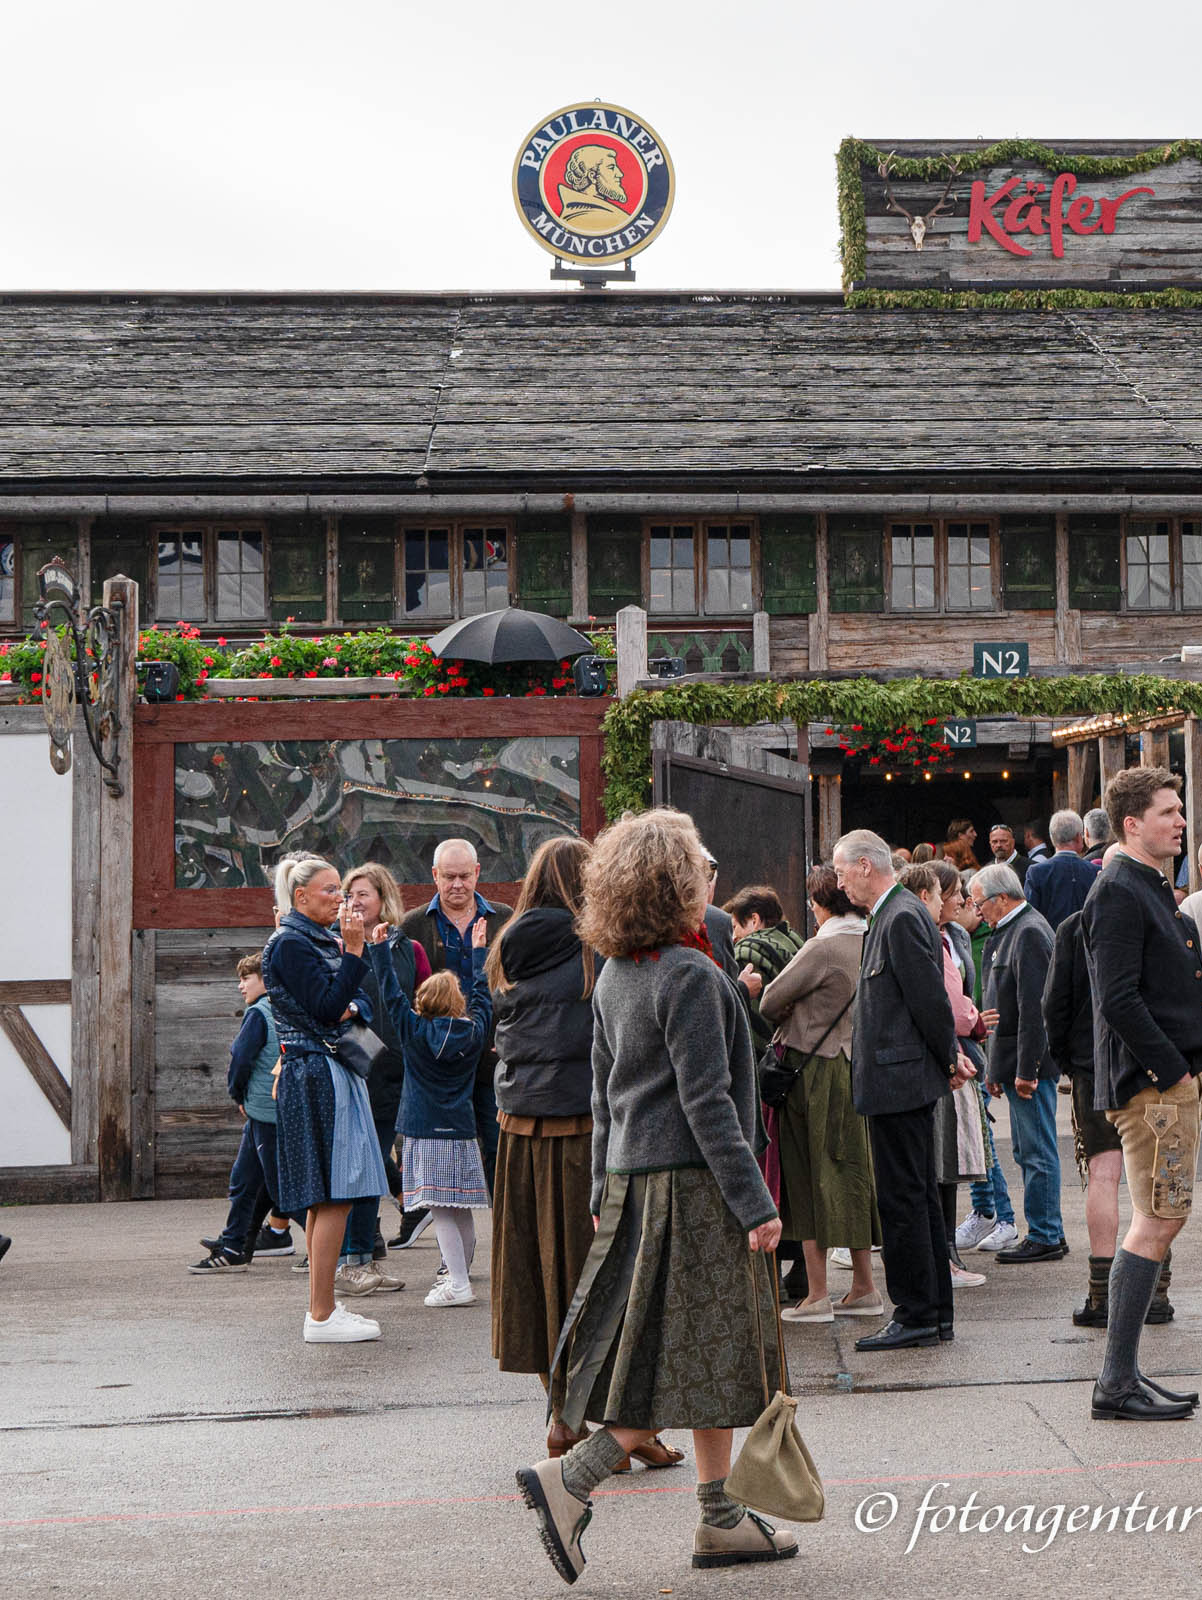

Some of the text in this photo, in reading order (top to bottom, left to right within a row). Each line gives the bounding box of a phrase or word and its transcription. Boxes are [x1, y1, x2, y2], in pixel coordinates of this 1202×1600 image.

[520, 110, 665, 173] PAULANER
[531, 211, 657, 256] MÜNCHEN
[967, 173, 1156, 258] Käfer
[982, 650, 1021, 675] N2
[943, 725, 972, 744] N2
